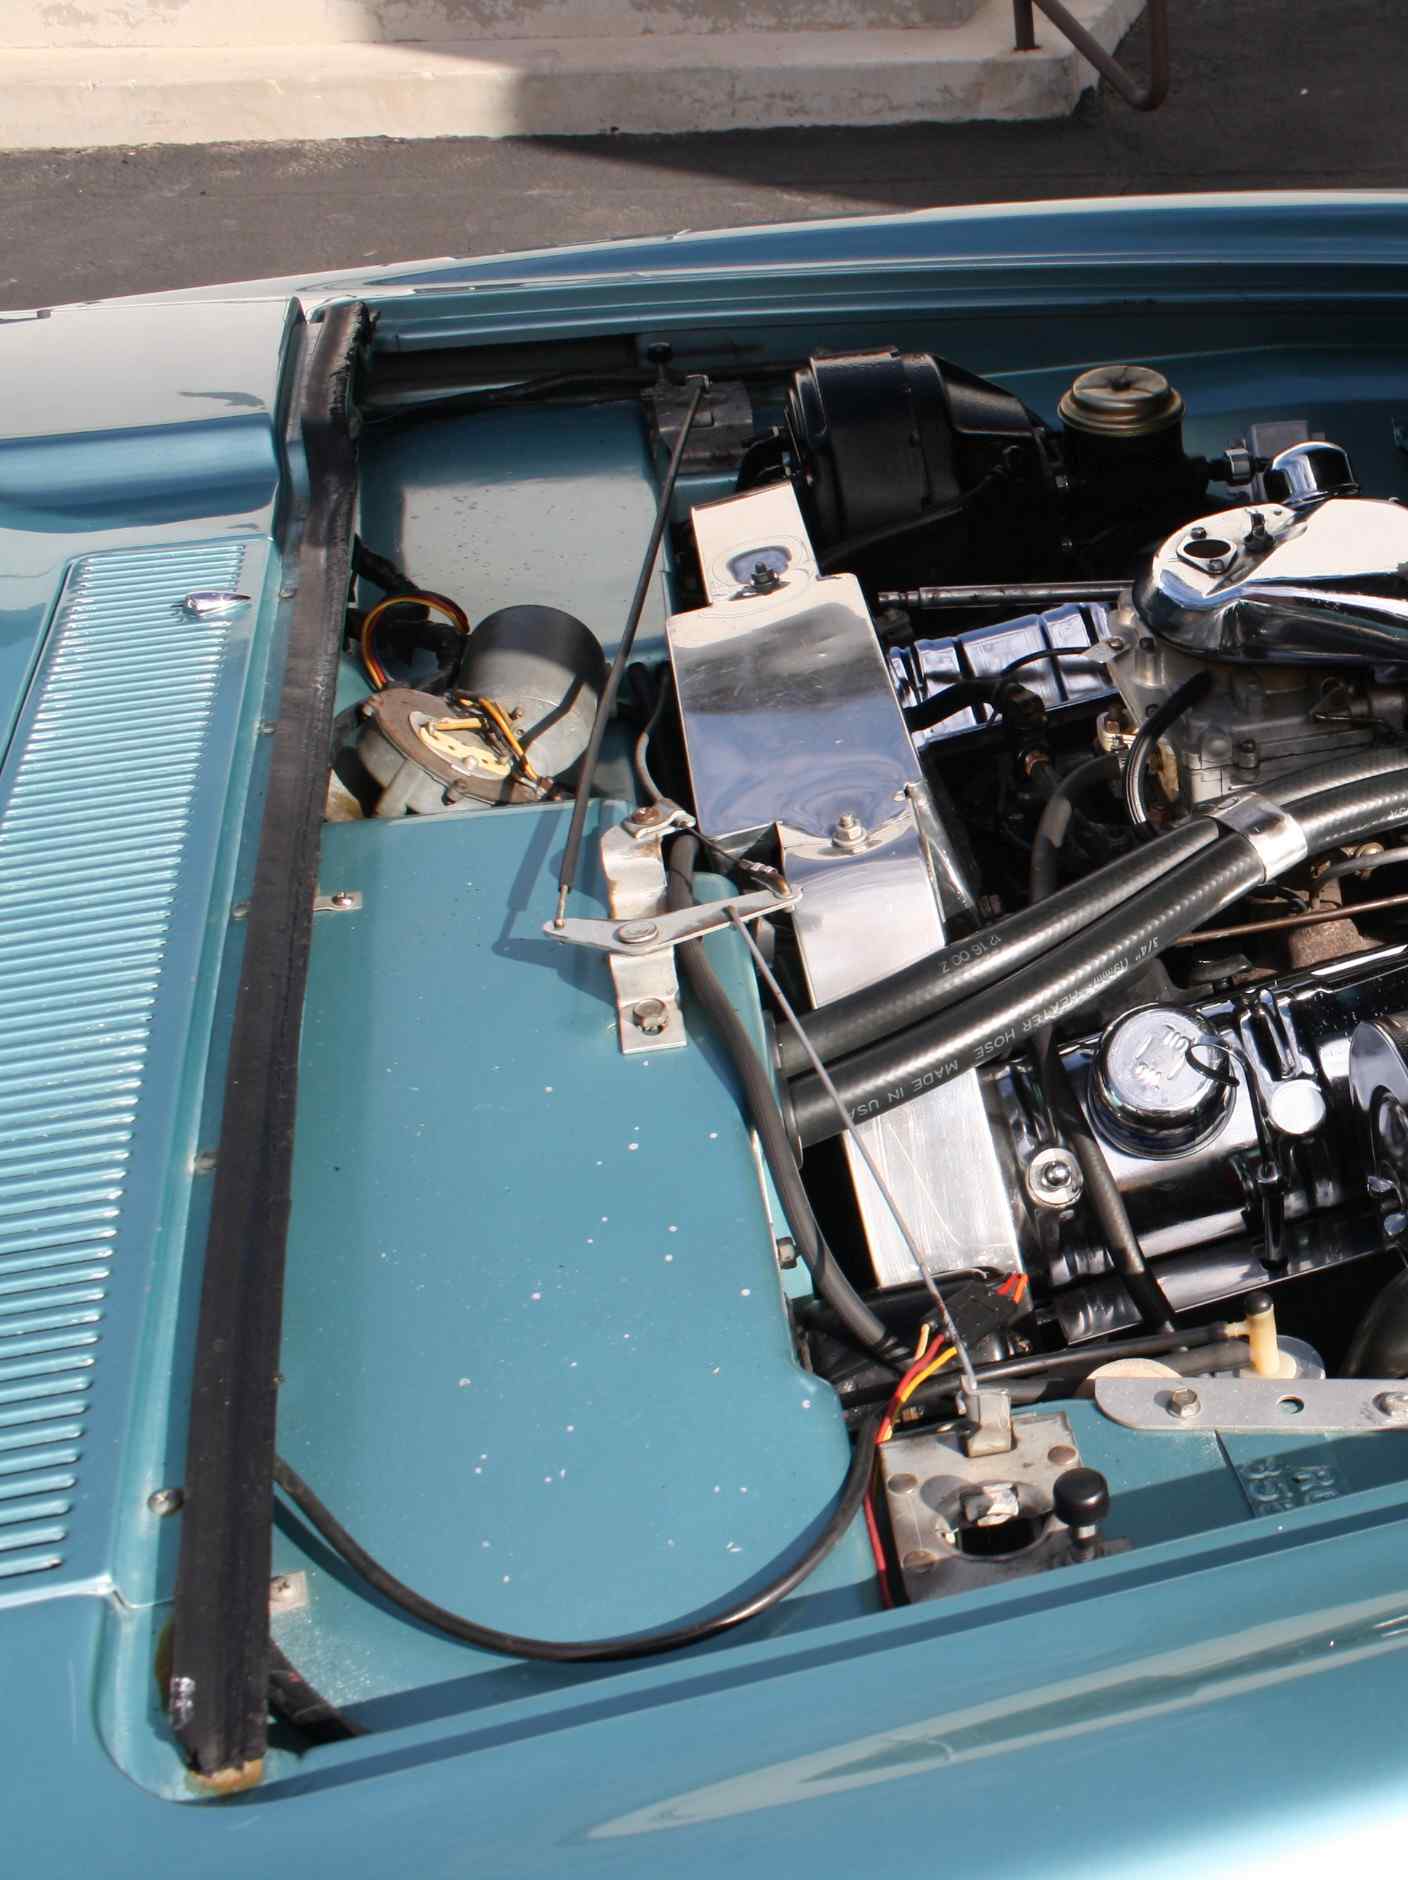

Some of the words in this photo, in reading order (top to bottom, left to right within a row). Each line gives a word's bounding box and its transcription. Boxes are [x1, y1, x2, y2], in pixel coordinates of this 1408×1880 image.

[1023, 990, 1082, 1032] HEATER
[975, 1028, 1016, 1059] HOSE
[911, 1059, 959, 1092] MADE
[887, 1087, 905, 1103] IN
